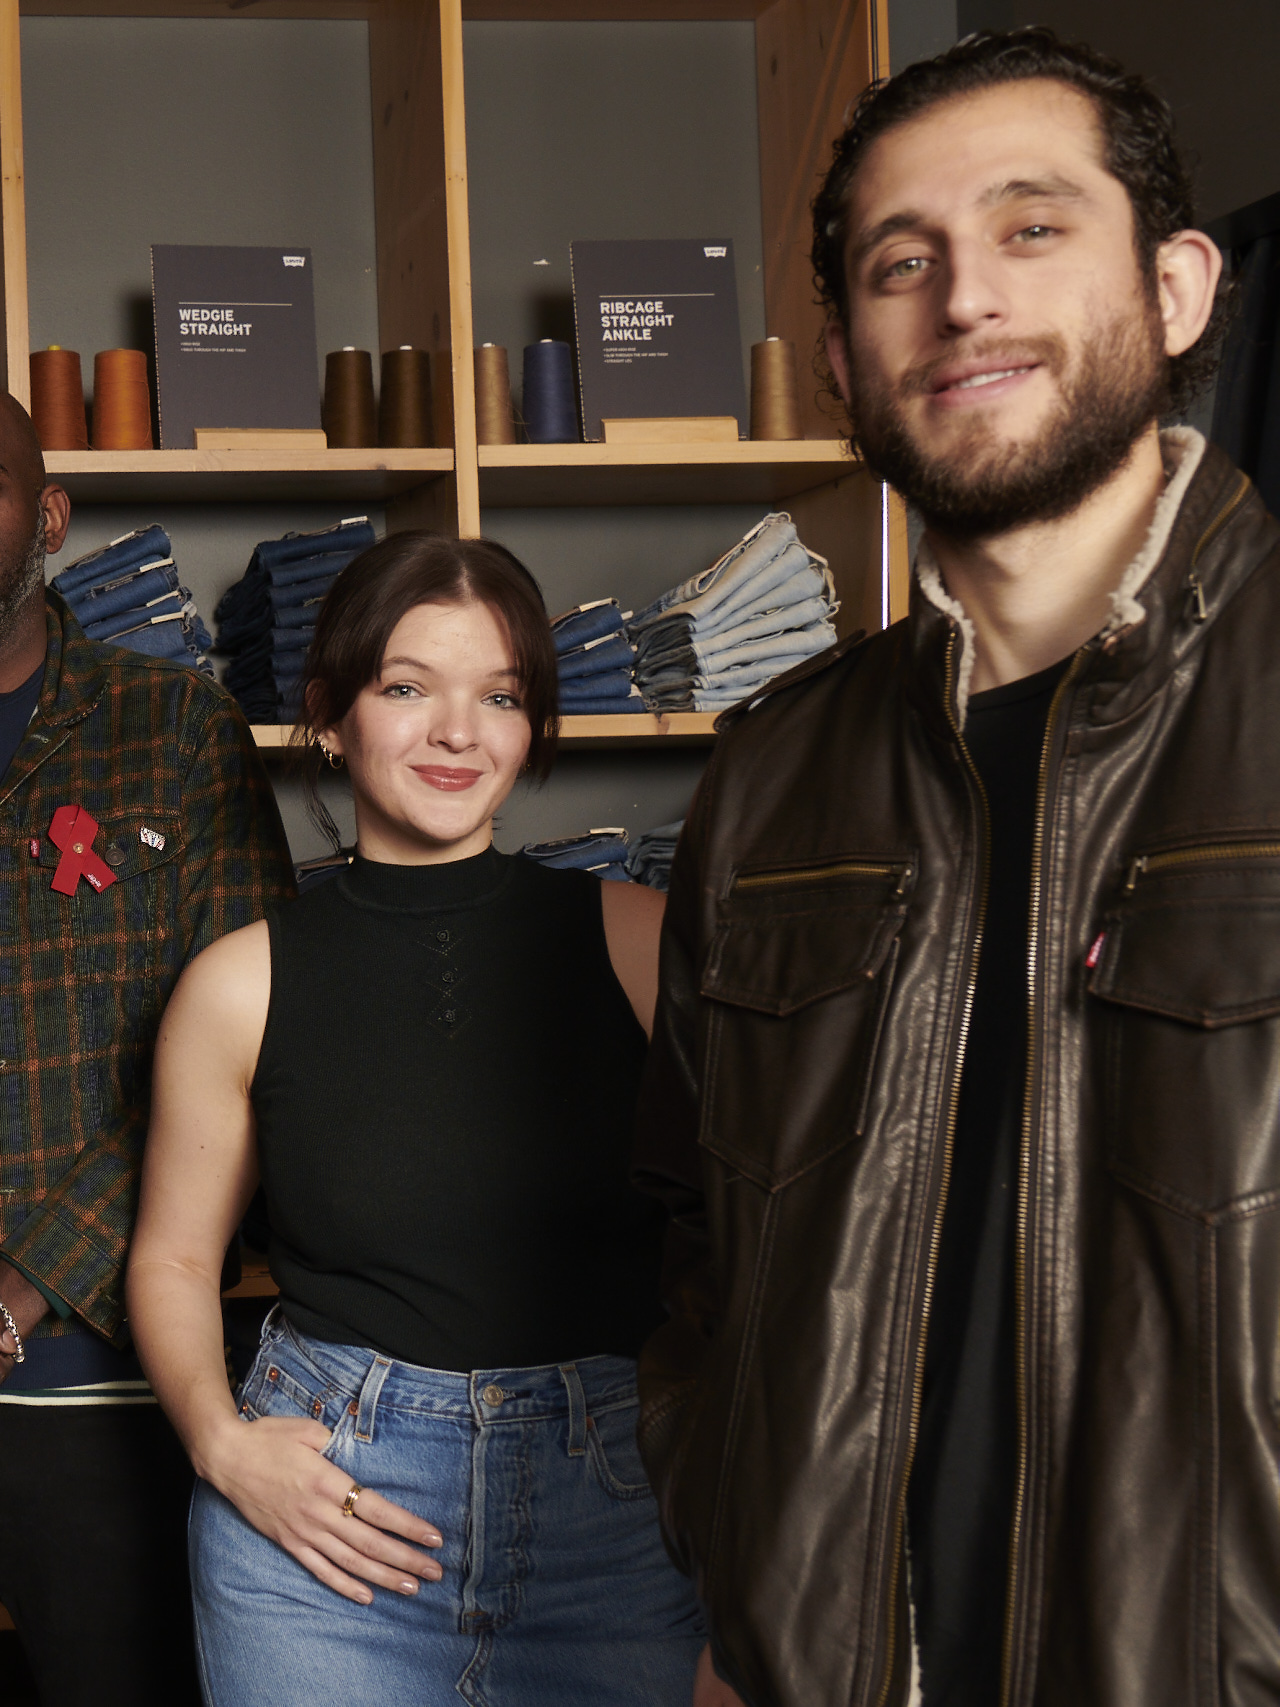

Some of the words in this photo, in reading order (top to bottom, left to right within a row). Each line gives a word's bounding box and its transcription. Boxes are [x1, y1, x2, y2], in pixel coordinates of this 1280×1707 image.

[600, 301, 664, 314] RIBCAGE
[179, 309, 235, 322] WEDGIE
[601, 314, 674, 328] STRAIGHT
[180, 322, 252, 336] STRAIGHT
[602, 328, 653, 342] ANKLE
